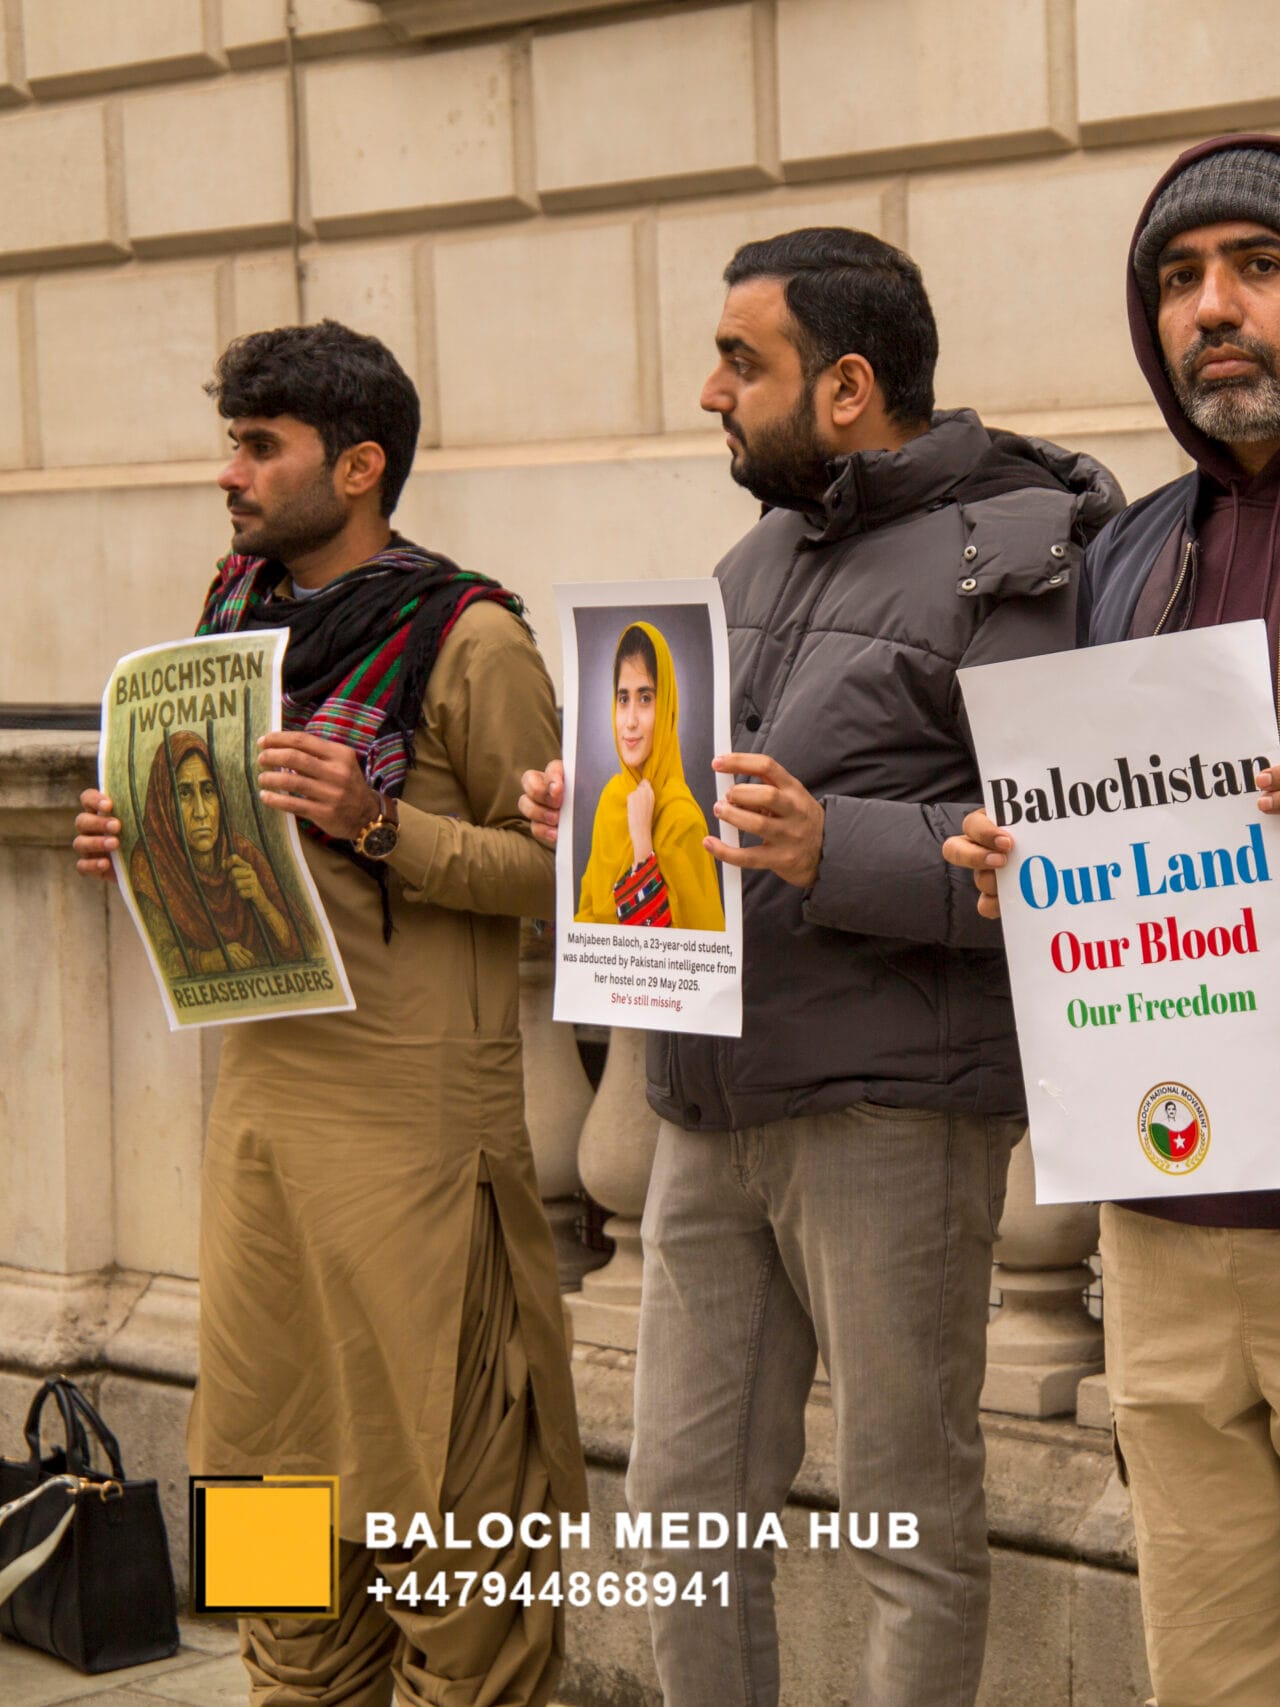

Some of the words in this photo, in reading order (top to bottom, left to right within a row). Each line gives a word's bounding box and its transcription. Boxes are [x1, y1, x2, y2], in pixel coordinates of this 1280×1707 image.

[115, 650, 265, 706] BALOCHISTAN
[138, 688, 237, 732] WOMAN
[987, 752, 1272, 827] Balochistan
[1018, 853, 1122, 911] Our
[1129, 822, 1273, 899] Land
[567, 933, 611, 948] Mahjabeen
[612, 936, 642, 949] Baloch,
[649, 938, 697, 953] 23-year-old
[698, 943, 733, 957] student,
[1050, 929, 1130, 974] Our
[1136, 907, 1261, 965] Blood
[562, 953, 578, 963] was
[578, 952, 617, 966] abducted
[618, 955, 630, 968] by
[630, 958, 667, 970] Pakistani
[668, 960, 716, 975] intelligence
[717, 962, 737, 975] from
[594, 972, 608, 983] her
[609, 973, 635, 986] hostel
[636, 976, 647, 987] on
[648, 976, 659, 988] 29
[659, 977, 678, 991] May
[678, 979, 701, 991] 2025.
[174, 969, 334, 1009] RELEASEBYCLEADERS
[611, 993, 634, 1006] She's
[633, 994, 650, 1006] still
[650, 996, 684, 1012] missing.
[1067, 998, 1122, 1029] Our
[1126, 983, 1258, 1024] Freedom
[1141, 1101, 1151, 1132] BALOCH
[1150, 1086, 1179, 1105] NATIONAL
[1180, 1090, 1207, 1129] MOVEMENT
